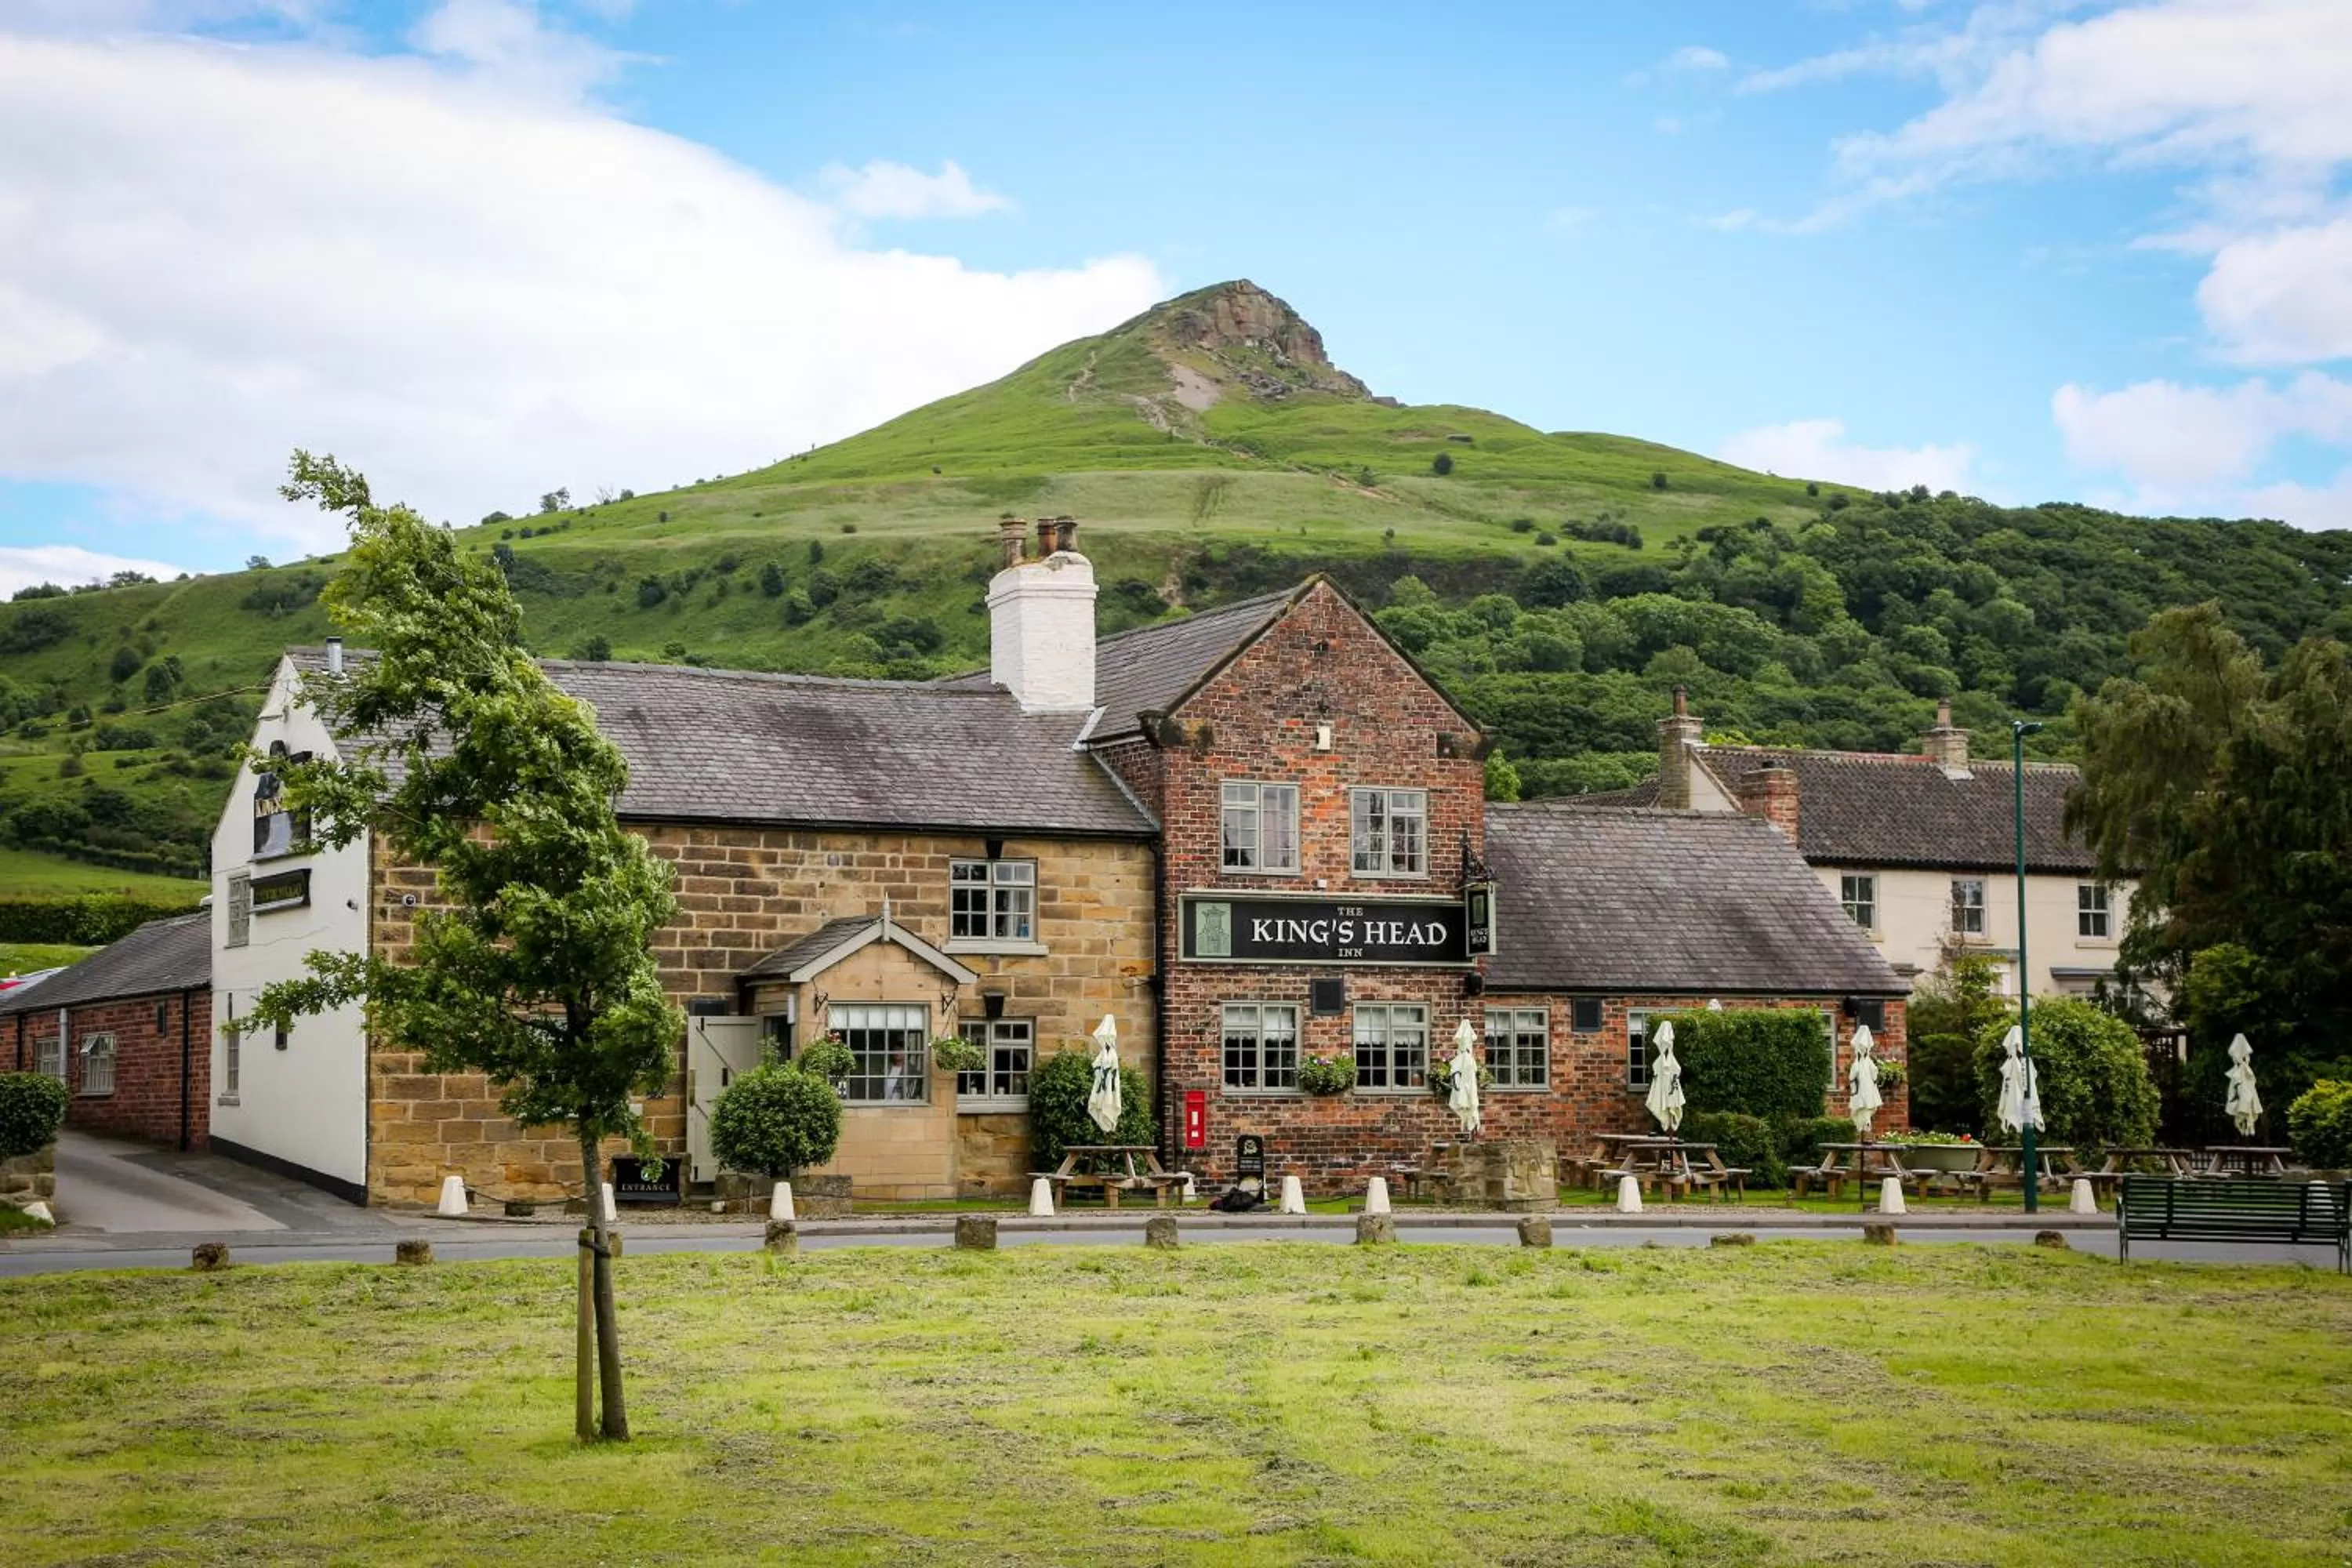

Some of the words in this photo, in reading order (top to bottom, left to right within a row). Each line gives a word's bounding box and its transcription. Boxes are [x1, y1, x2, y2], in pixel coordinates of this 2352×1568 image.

[1337, 906, 1363, 916] THE
[1251, 918, 1354, 946] KING'S
[1363, 921, 1447, 946] HEAD
[1338, 948, 1363, 957] INN
